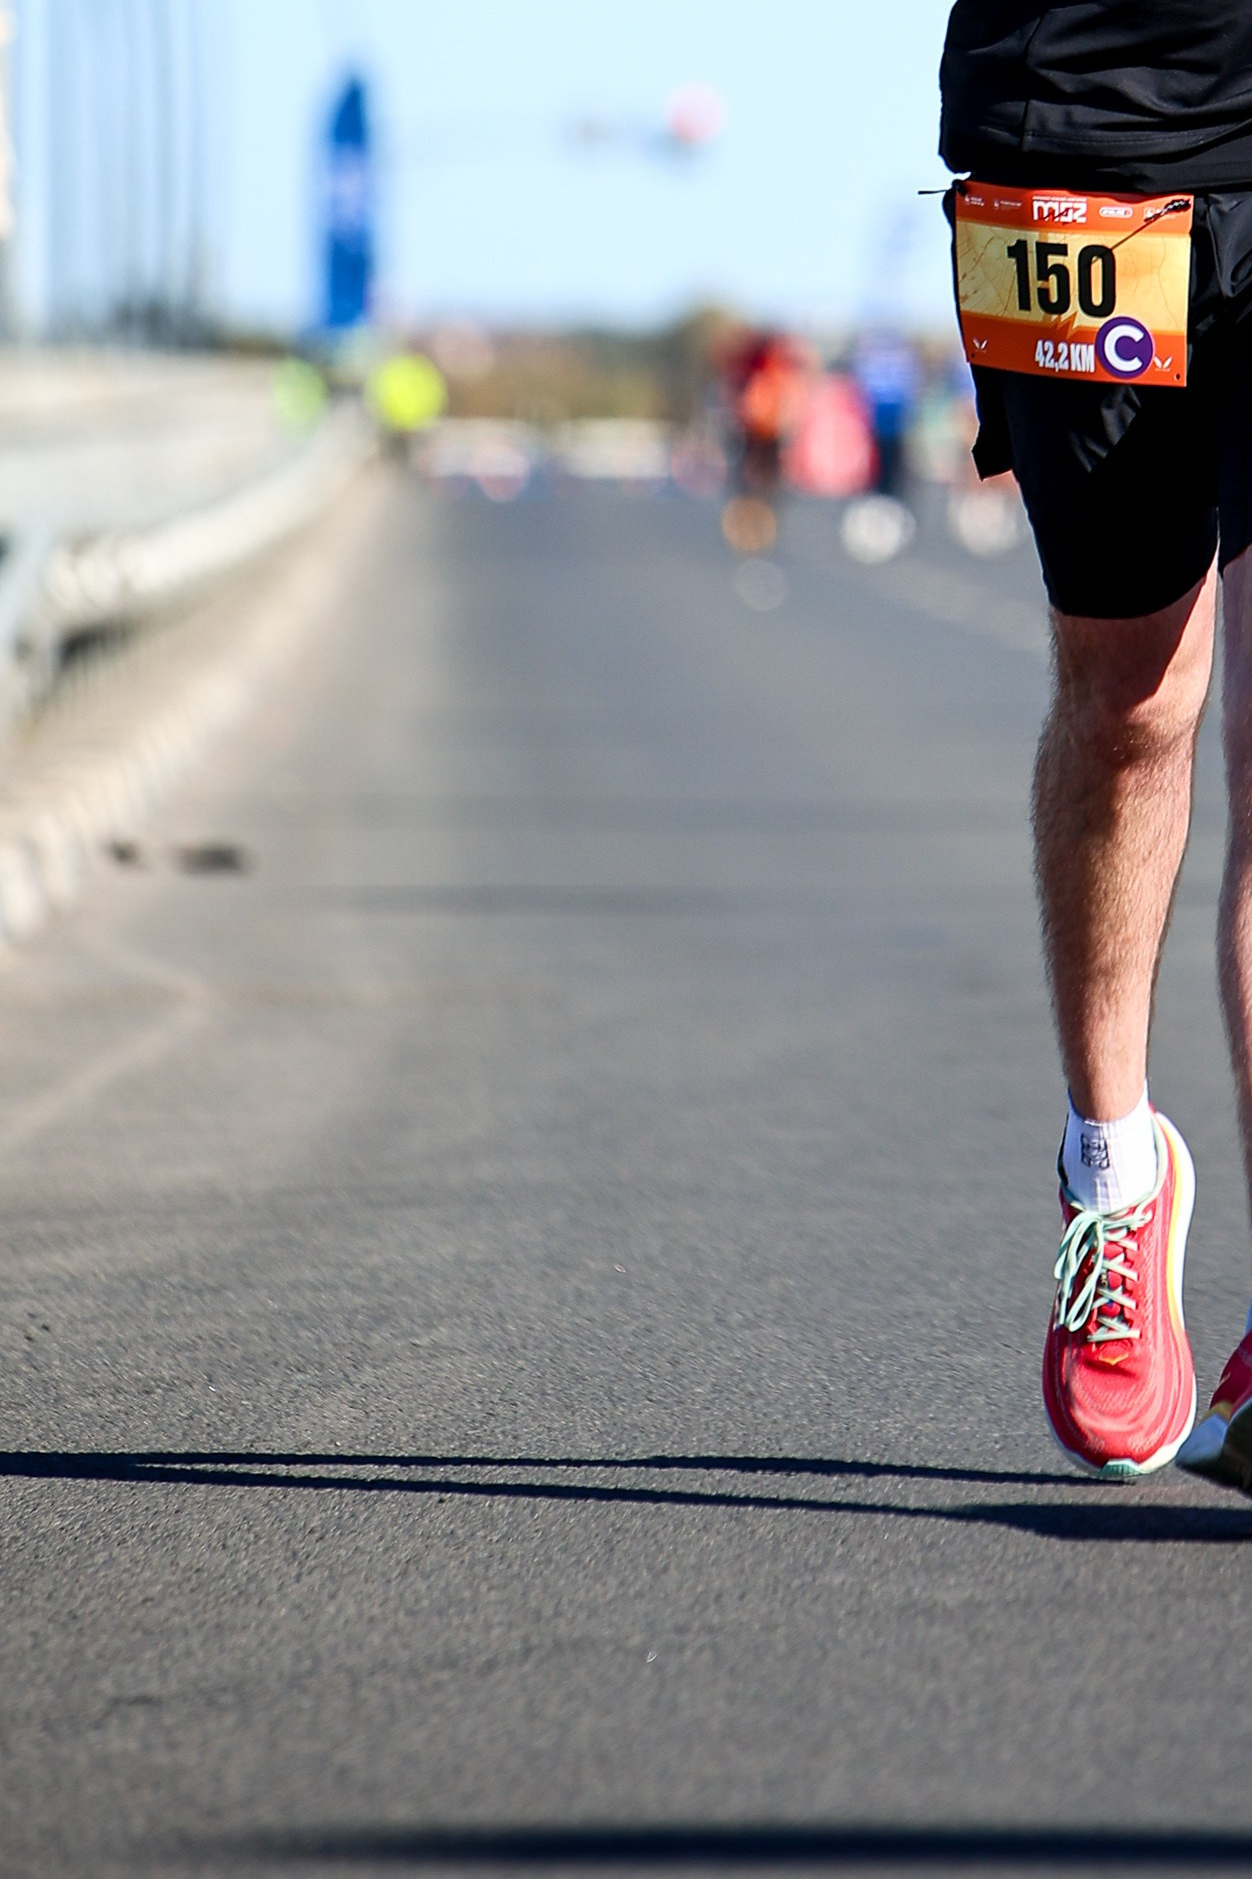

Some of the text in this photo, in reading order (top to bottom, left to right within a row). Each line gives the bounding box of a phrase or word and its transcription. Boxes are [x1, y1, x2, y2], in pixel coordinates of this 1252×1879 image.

[1007, 239, 1116, 318] 150
[1034, 339, 1095, 373] 42,2 KM
[1103, 324, 1144, 372] C
